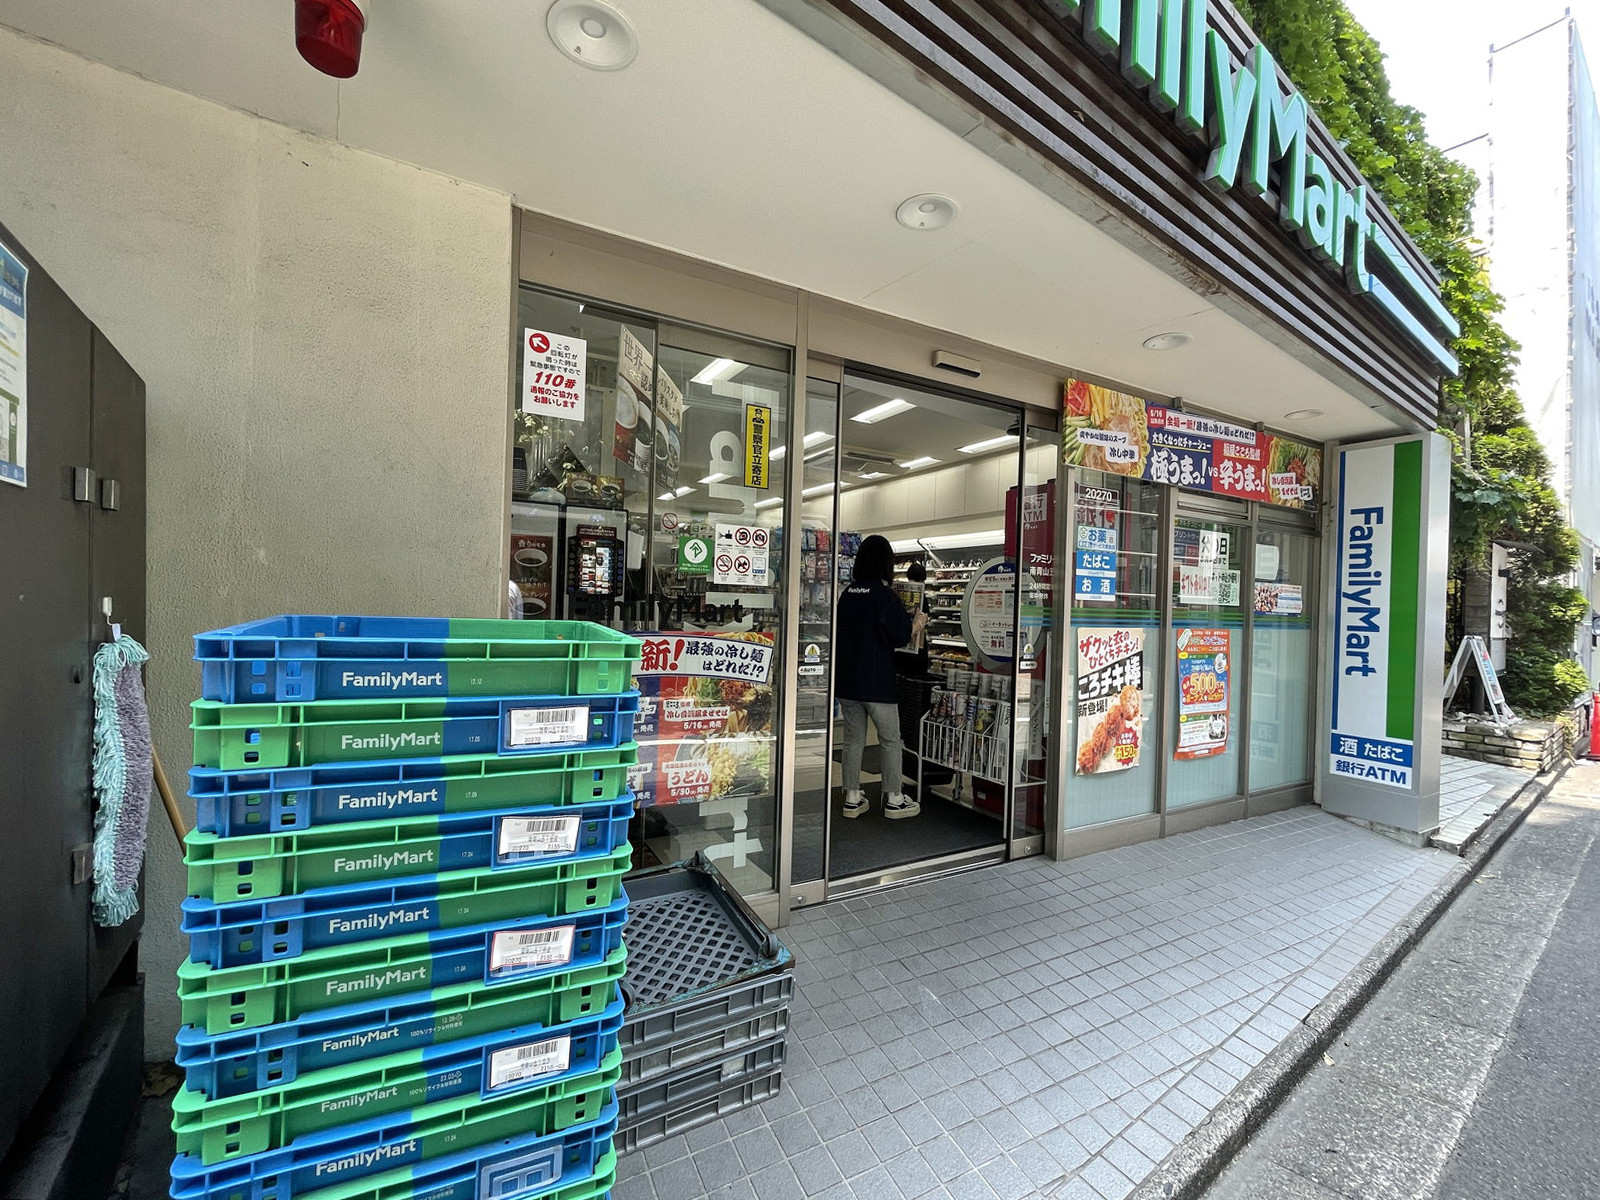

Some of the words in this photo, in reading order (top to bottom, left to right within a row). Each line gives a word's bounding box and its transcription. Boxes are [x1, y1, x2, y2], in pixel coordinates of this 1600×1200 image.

[551, 350, 578, 360] 回転灯が
[557, 343, 570, 351] この
[530, 361, 581, 376] 緊急事態ですので
[545, 356, 577, 368] 鳴った時は
[535, 371, 577, 389] 110番
[530, 385, 580, 401] 通報のご協力を
[533, 395, 576, 409] お願いします
[751, 424, 764, 486] 警察官立寄店
[1086, 488, 1112, 501] 20270
[1088, 529, 1107, 543] お薬
[1030, 553, 1054, 563] ファミリ
[1082, 553, 1111, 569] たばこ
[1341, 506, 1384, 677] FamilyMart
[686, 641, 764, 663] 最強の冷し麺
[703, 660, 764, 678] はどれだ!?
[1078, 656, 1141, 699] ころチキ棒
[342, 671, 442, 689] FamilyMart
[1078, 698, 1108, 717] 新登場!
[341, 730, 441, 751] FamilyMart
[1340, 737, 1358, 756] 酒
[1364, 743, 1404, 762] たばこ
[671, 770, 709, 785] うどん
[1336, 760, 1406, 785] 銀行ATM
[338, 788, 438, 810] FamilyMart
[334, 850, 434, 873] FamilyMart
[329, 906, 430, 934] FamilyMart
[325, 965, 426, 996] FamilyMart
[322, 1027, 400, 1053] FamilyMart
[321, 1086, 397, 1113] FamilyMart
[315, 1139, 416, 1177] FamilyMart
